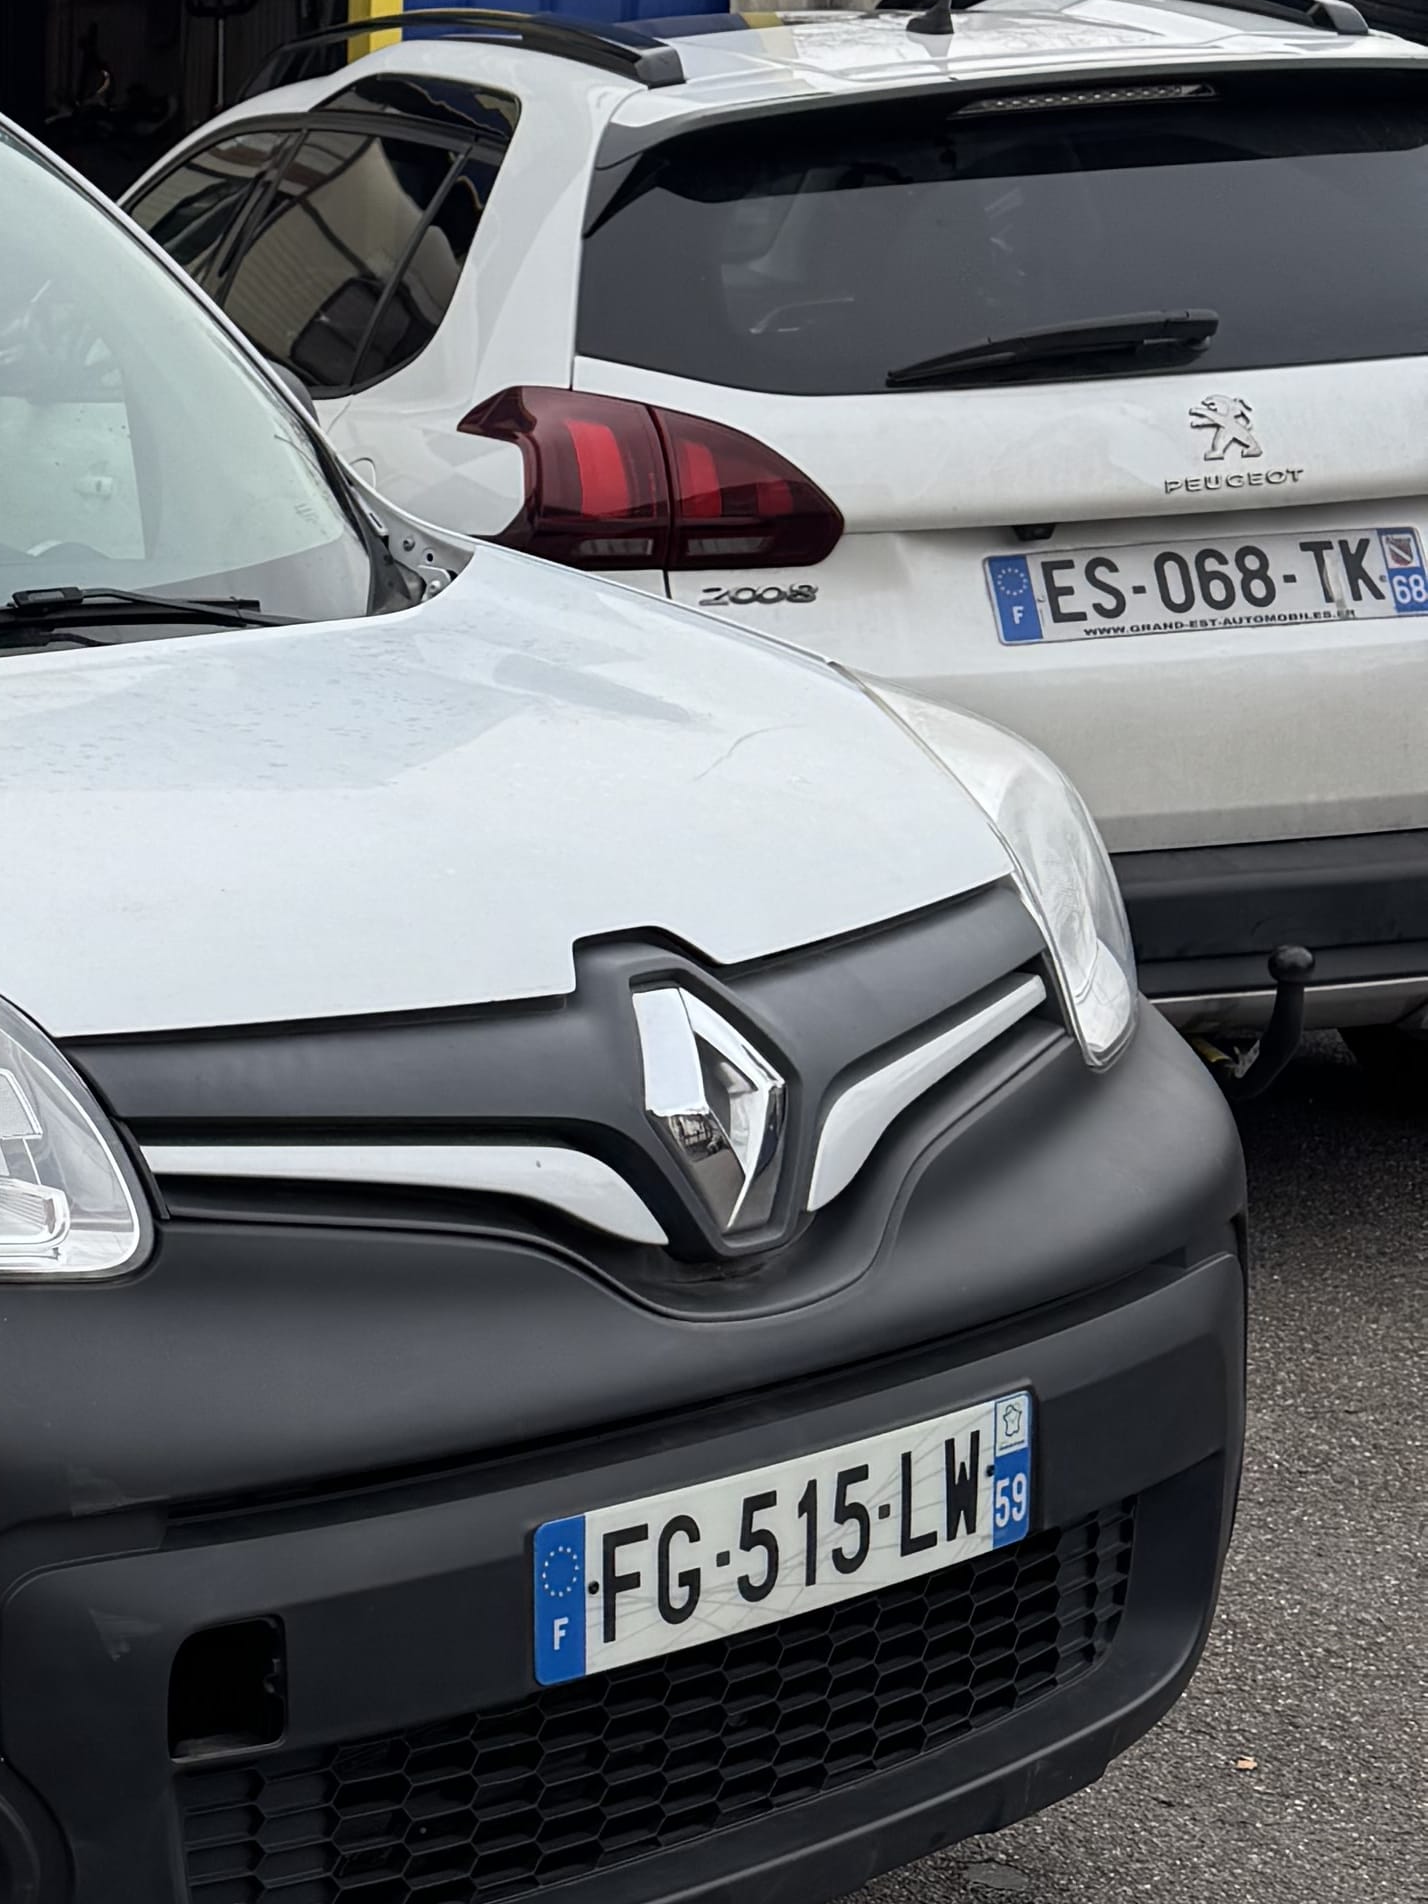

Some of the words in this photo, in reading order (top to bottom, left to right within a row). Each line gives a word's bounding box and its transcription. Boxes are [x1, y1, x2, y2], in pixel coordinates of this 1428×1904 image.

[1164, 468, 1304, 494] PEUGEOT
[698, 584, 818, 606] 2008
[1041, 538, 1386, 623] ES-068-TK
[1392, 575, 1426, 605] 68
[1012, 606, 1024, 625] F
[994, 1472, 1028, 1528] 59
[603, 1430, 979, 1643] FG-515-LW
[553, 1617, 569, 1650] F
